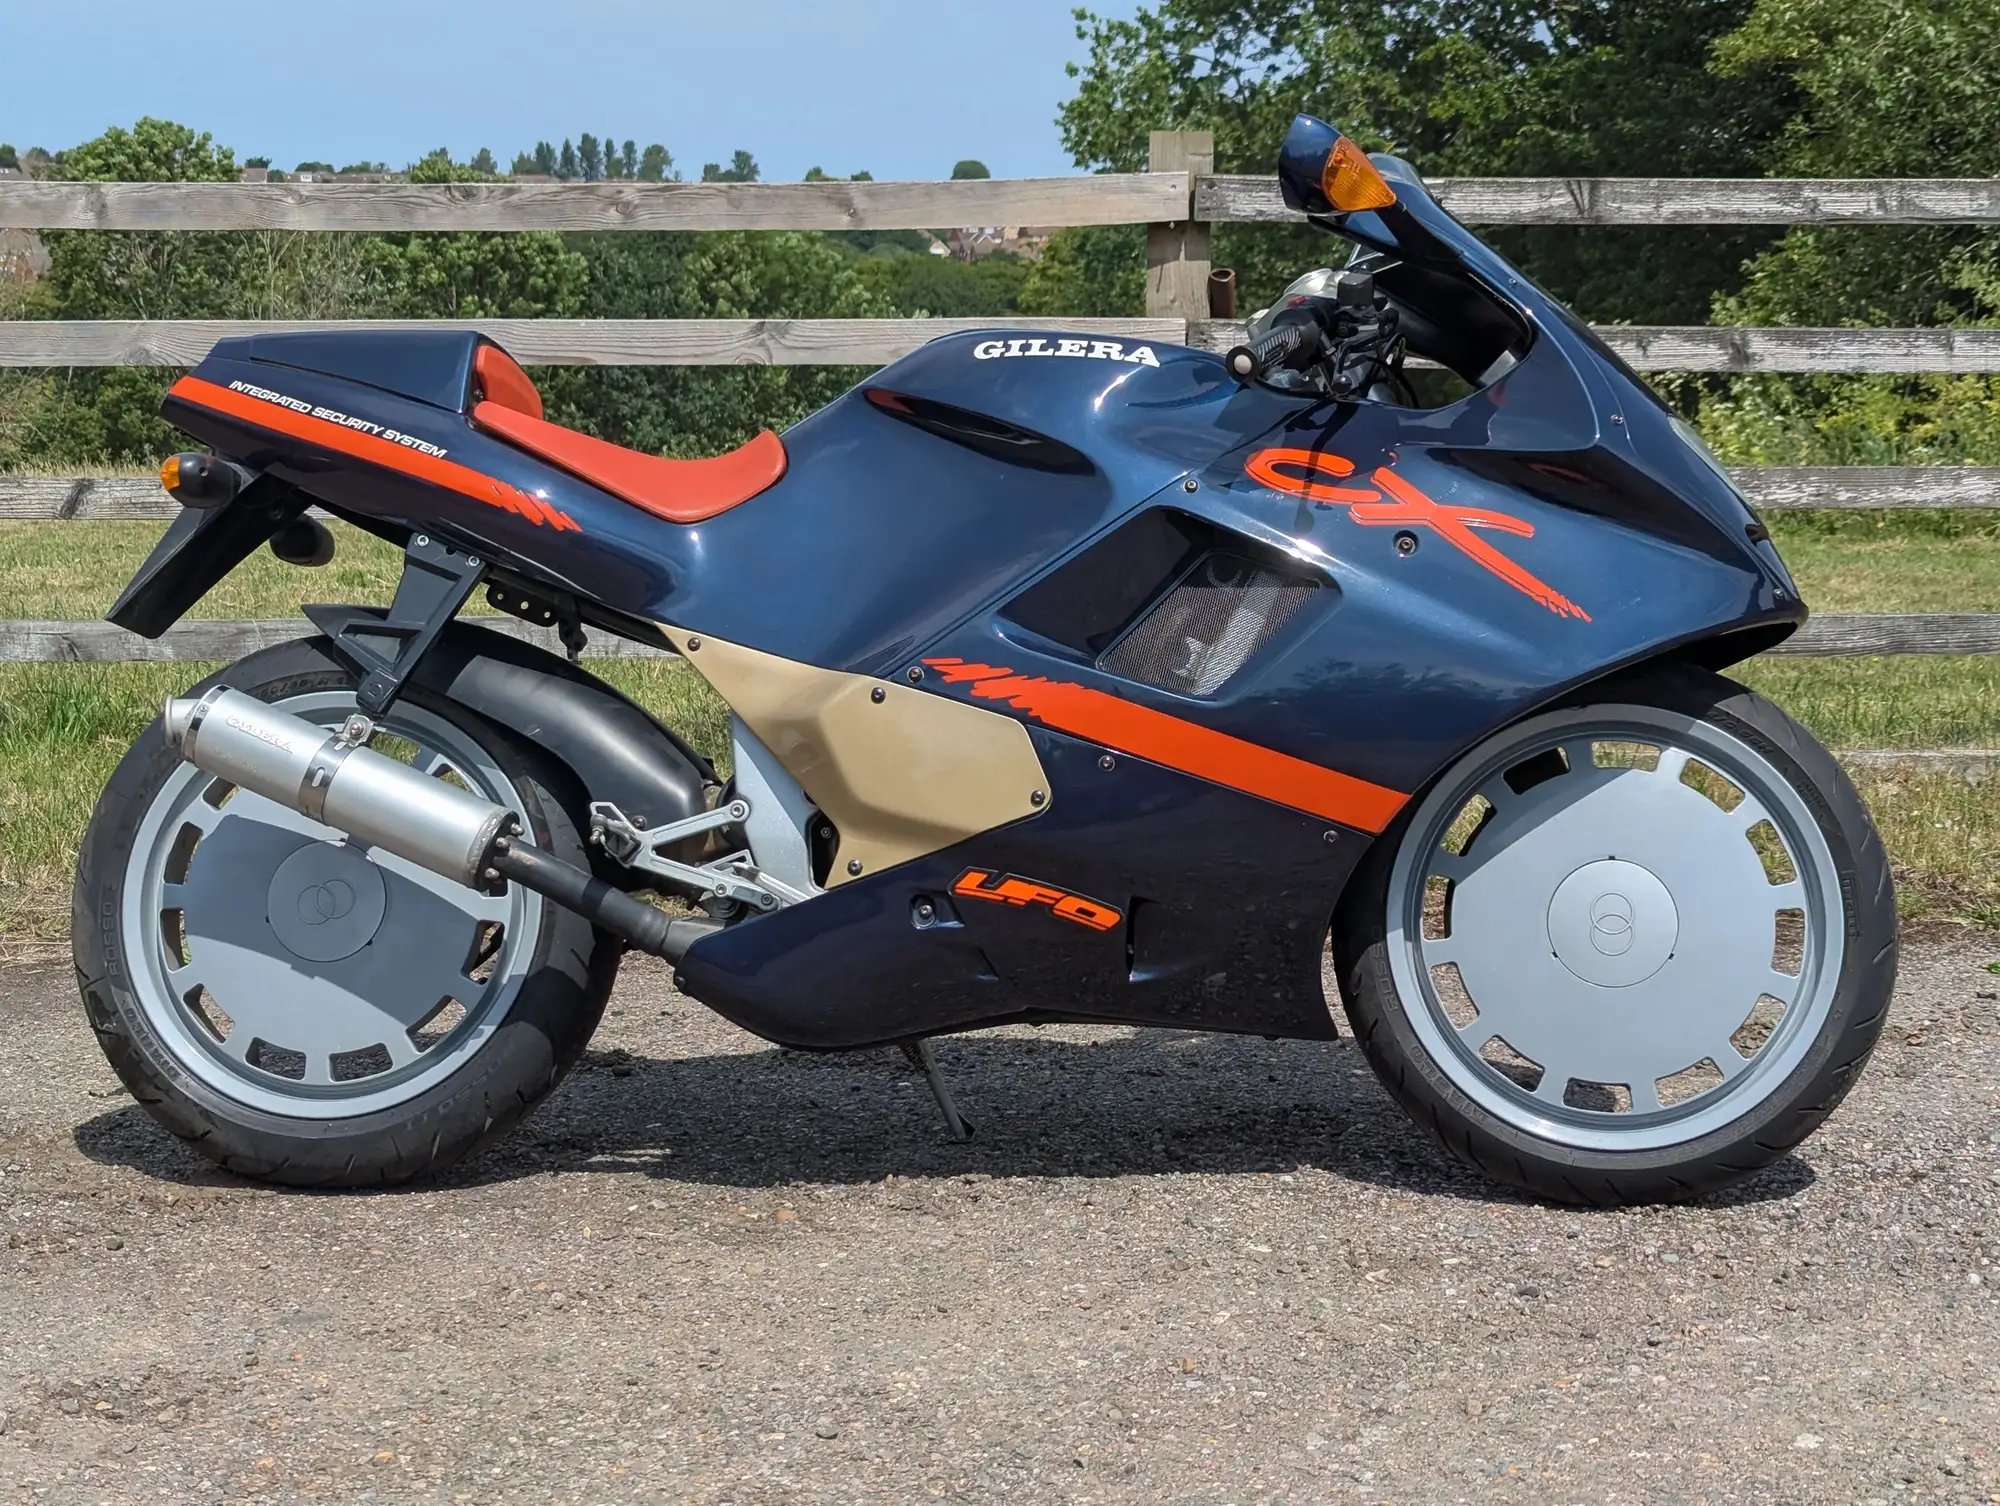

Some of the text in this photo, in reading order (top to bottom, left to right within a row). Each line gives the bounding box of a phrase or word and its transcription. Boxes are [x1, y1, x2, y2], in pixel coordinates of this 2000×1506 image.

[974, 339, 1161, 368] GILERA
[229, 380, 448, 459] INTEGRATED SECURITY SYSTEM
[101, 900, 120, 976] ROSSO
[1371, 925, 1488, 1126] DIABLO ROSSO
